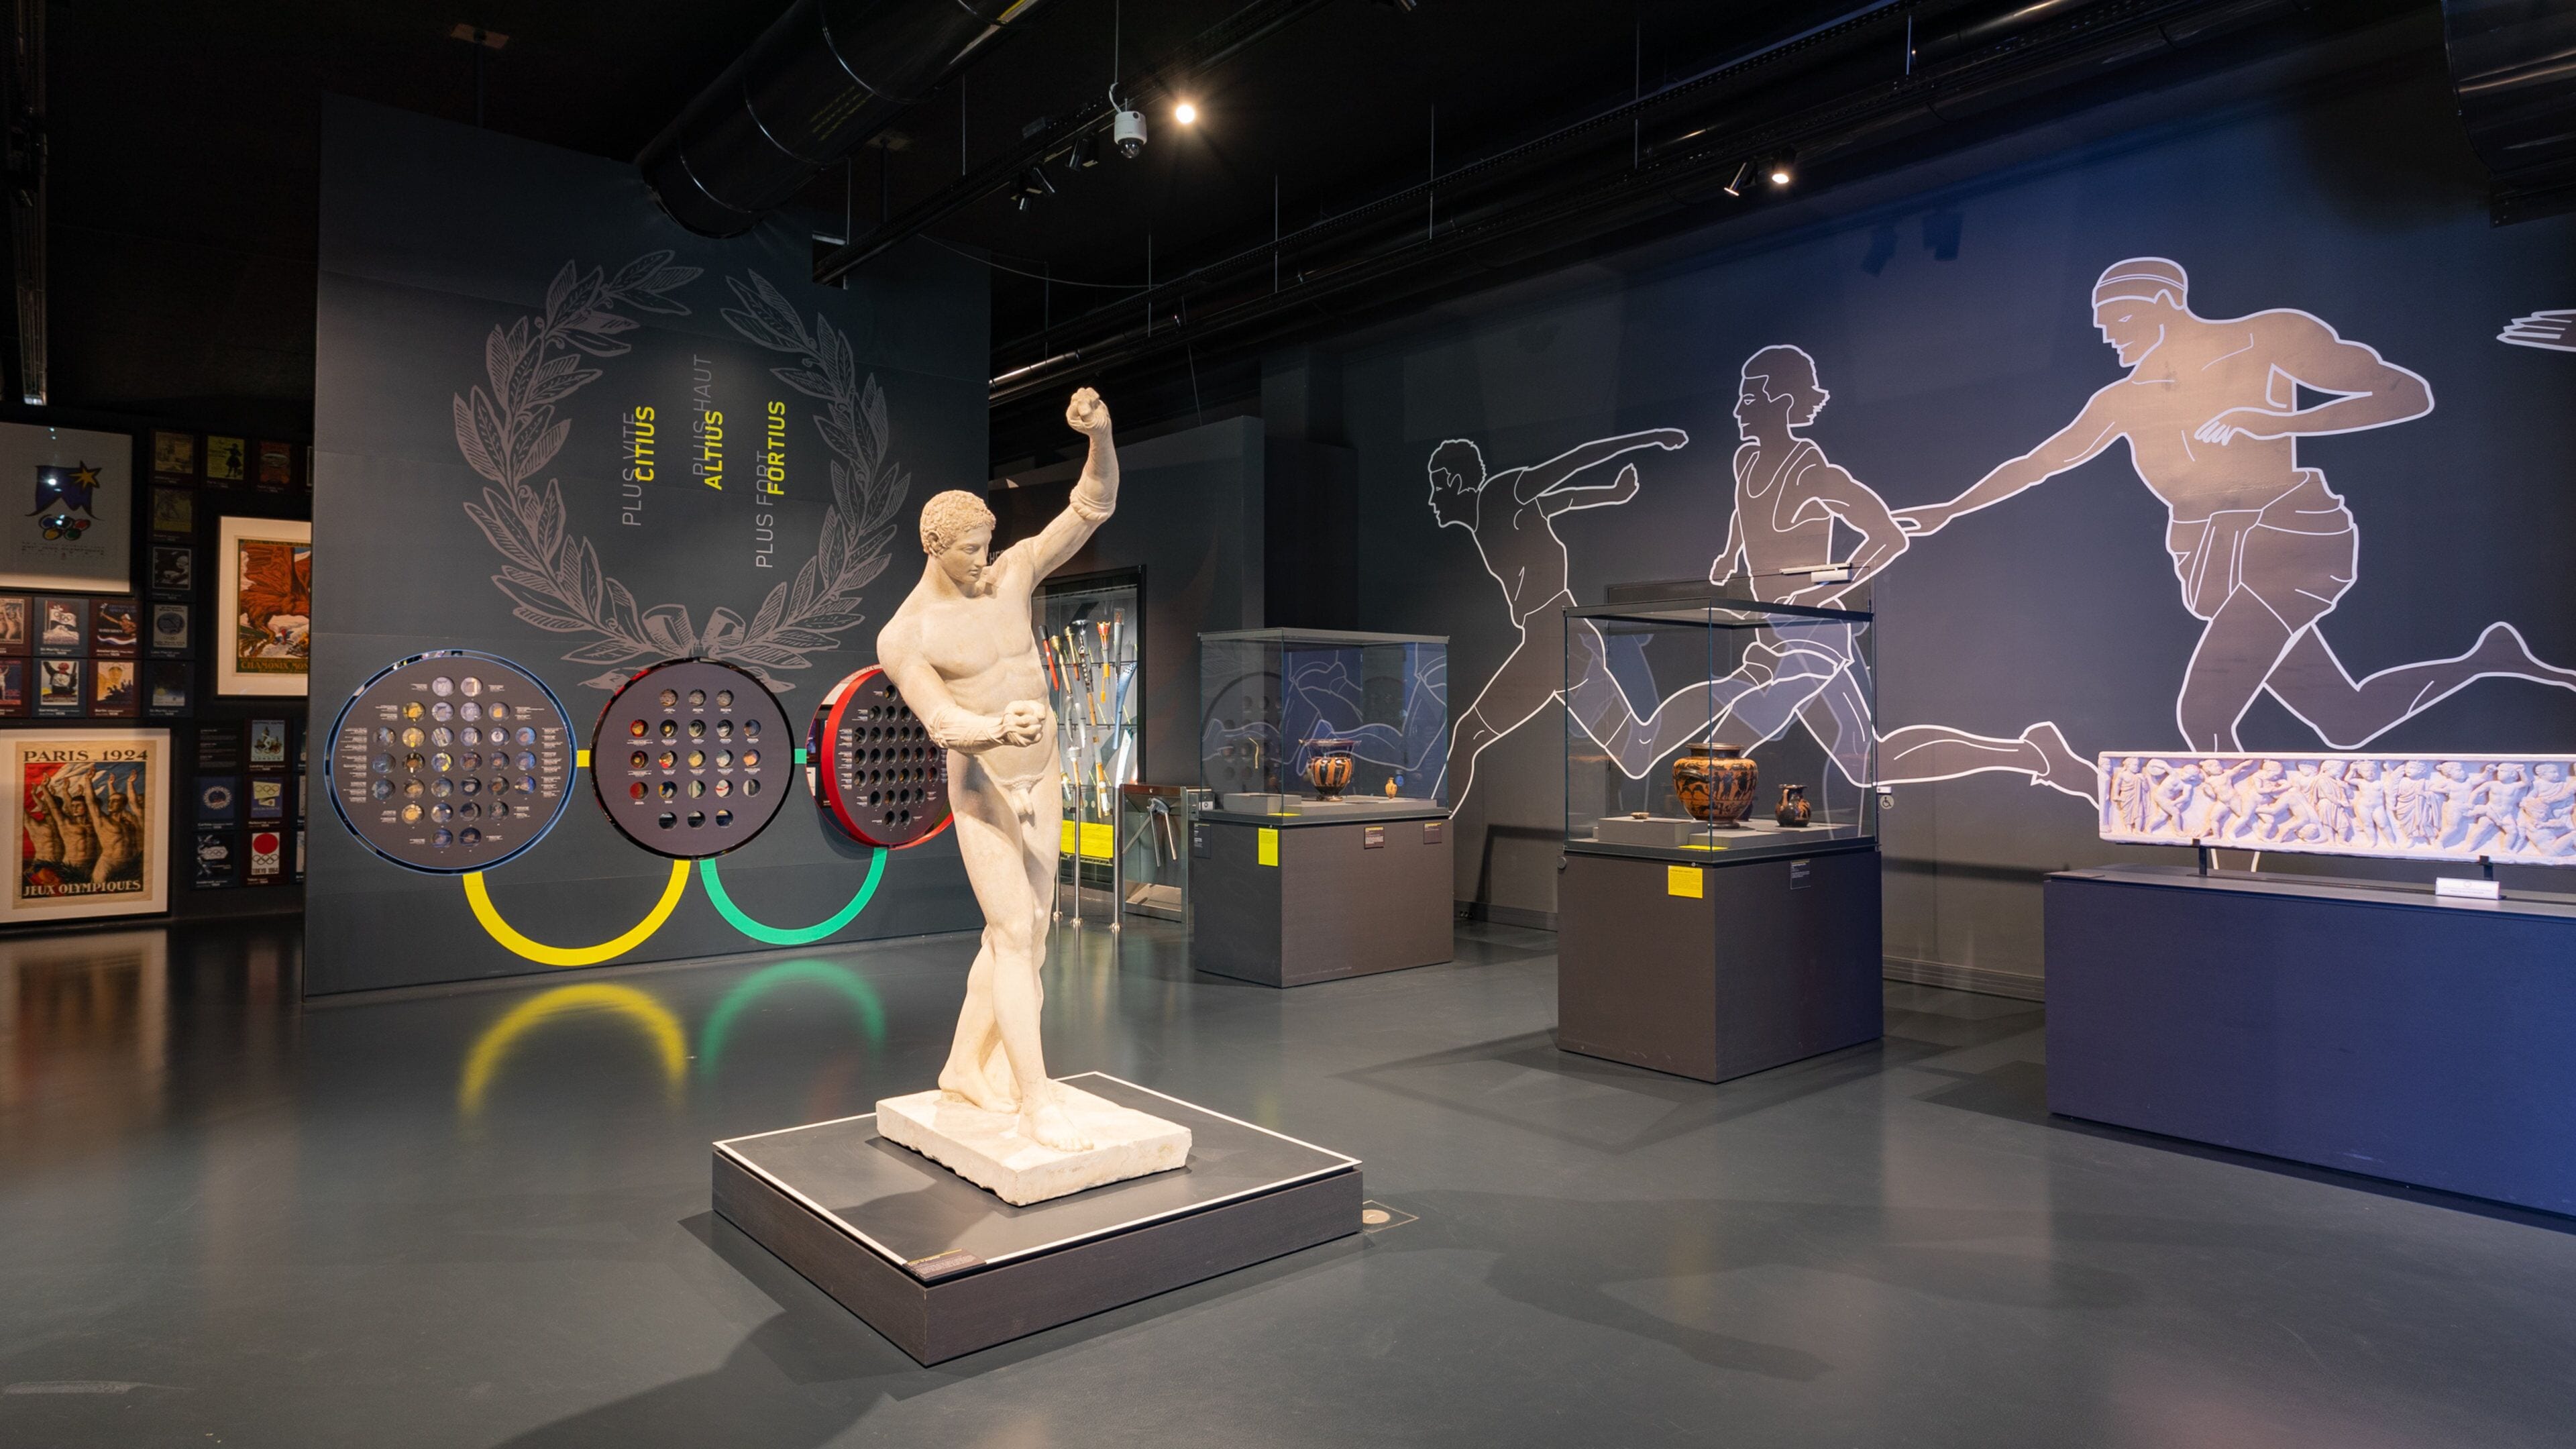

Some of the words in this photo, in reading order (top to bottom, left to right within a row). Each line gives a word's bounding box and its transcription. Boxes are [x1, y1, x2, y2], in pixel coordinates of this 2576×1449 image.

[694, 354, 712, 412] HAUT
[623, 413, 641, 460] VITE
[635, 406, 655, 481] CITIUS
[704, 411, 723, 490] ALTIUS
[767, 400, 785, 495] FORTIUS
[623, 468, 641, 526] PLUS
[757, 451, 773, 506] FORT
[756, 514, 773, 568] PLUS
[23, 750, 89, 761] PARIS
[102, 750, 148, 761] 1924
[23, 885, 55, 896] JEUX
[58, 880, 141, 894] OLYMPIQUES
